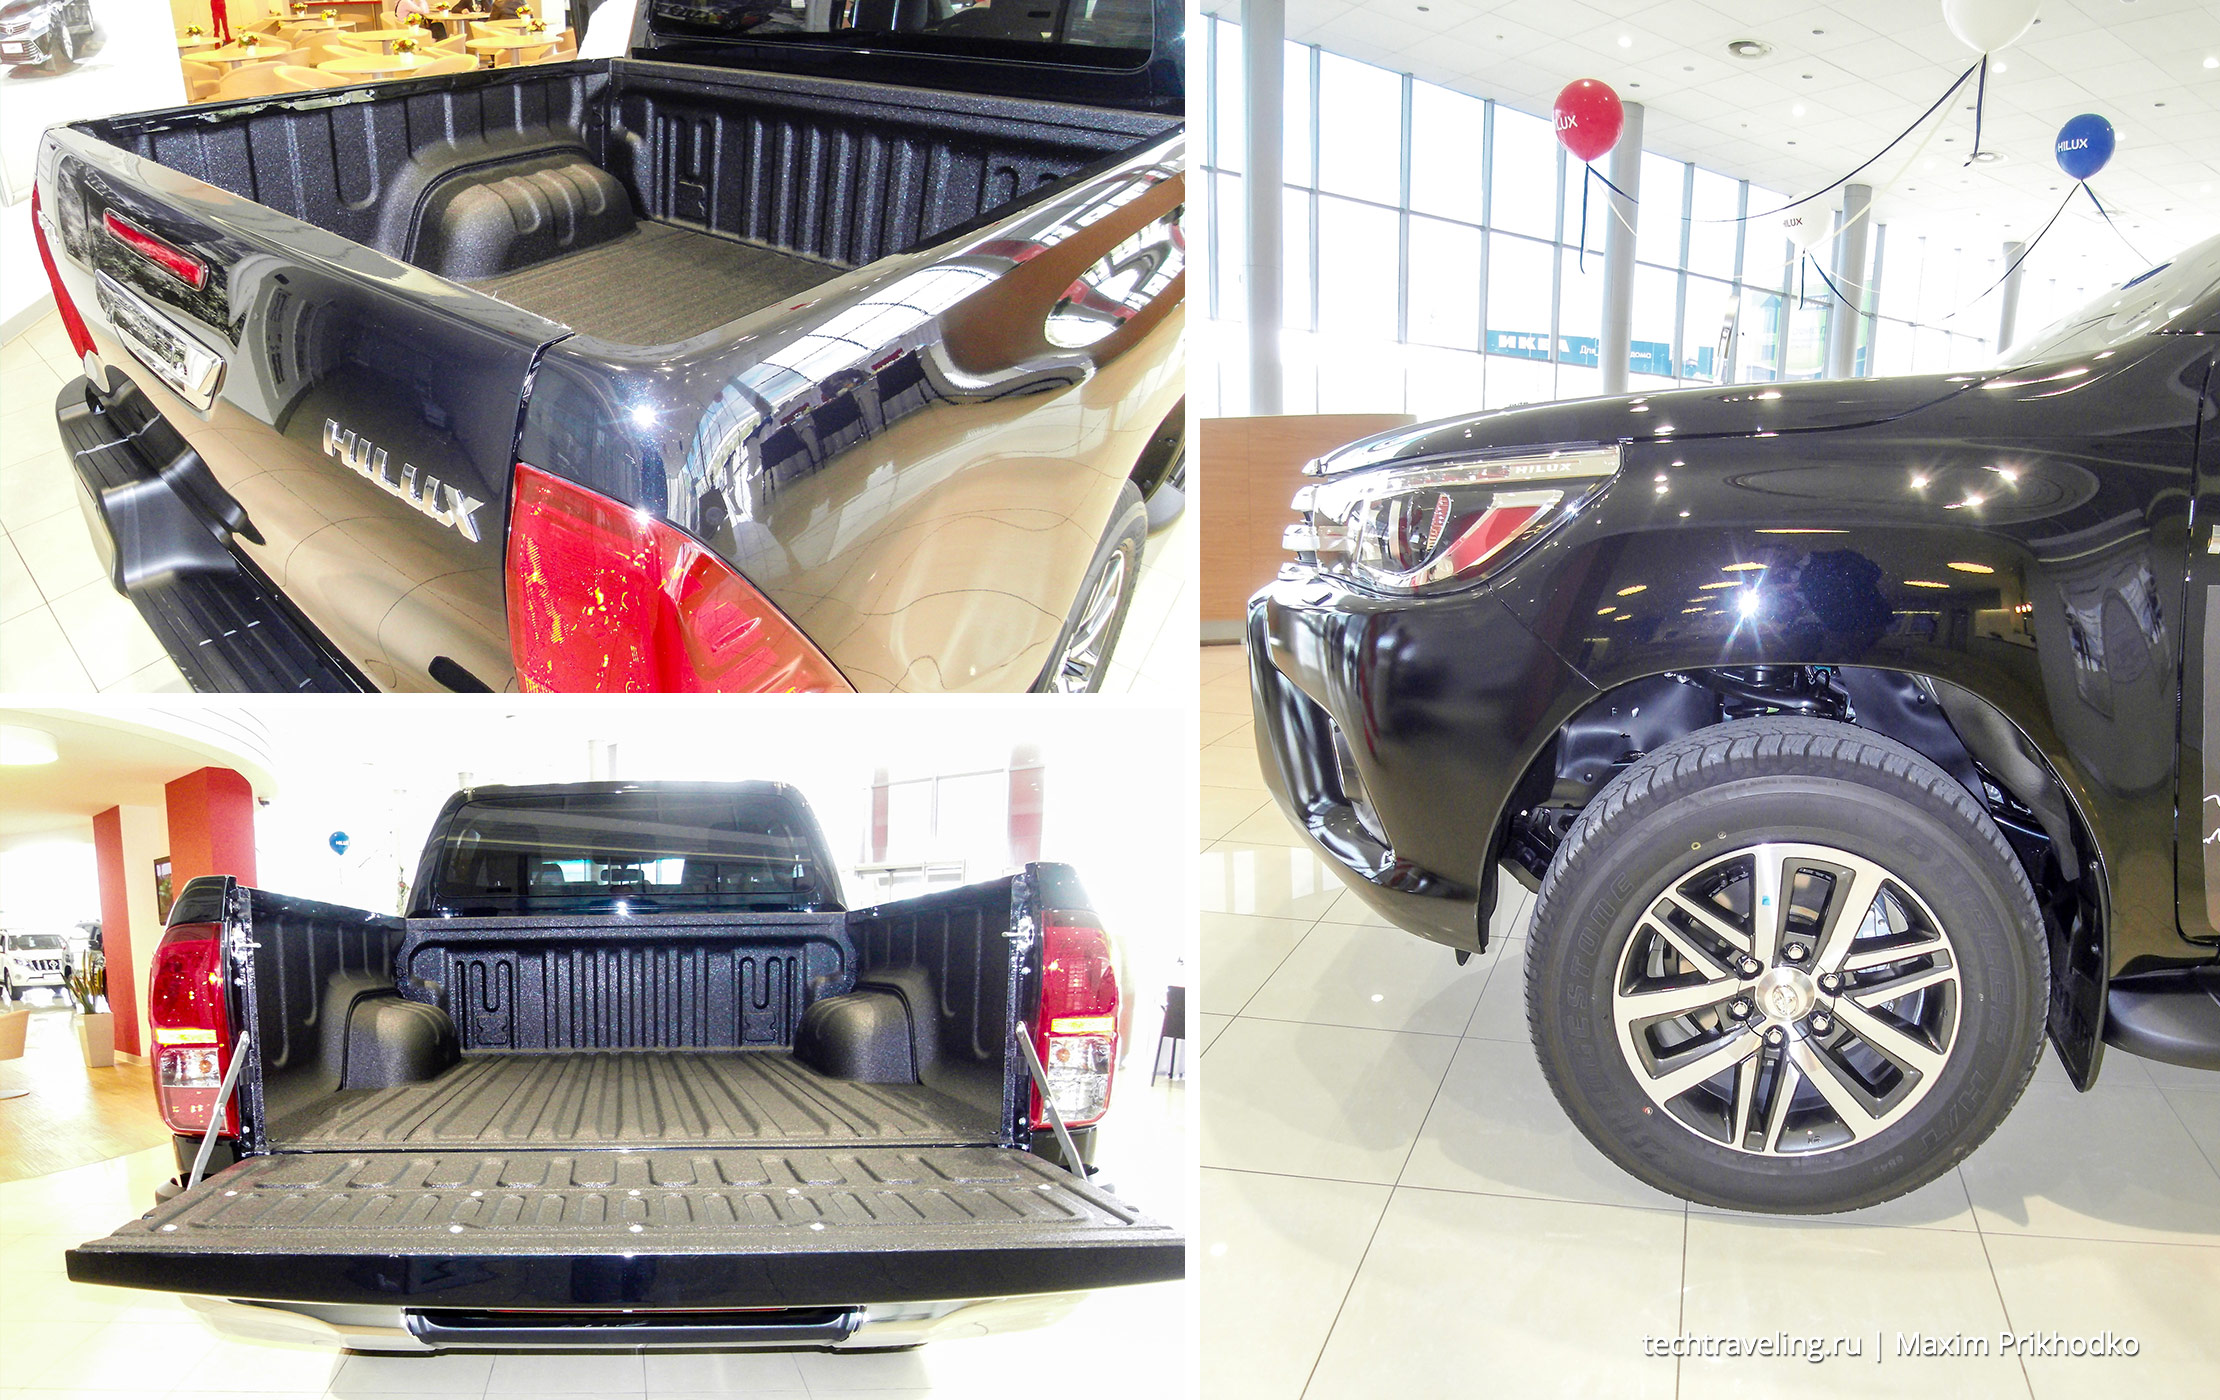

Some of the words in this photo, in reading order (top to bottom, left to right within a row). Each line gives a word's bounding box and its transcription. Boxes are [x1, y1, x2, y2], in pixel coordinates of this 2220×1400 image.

[2057, 138, 2089, 153] HILUX
[1498, 334, 1570, 352] ИКЕА
[1515, 463, 1572, 474] HILUX
[323, 418, 485, 543] HILUX
